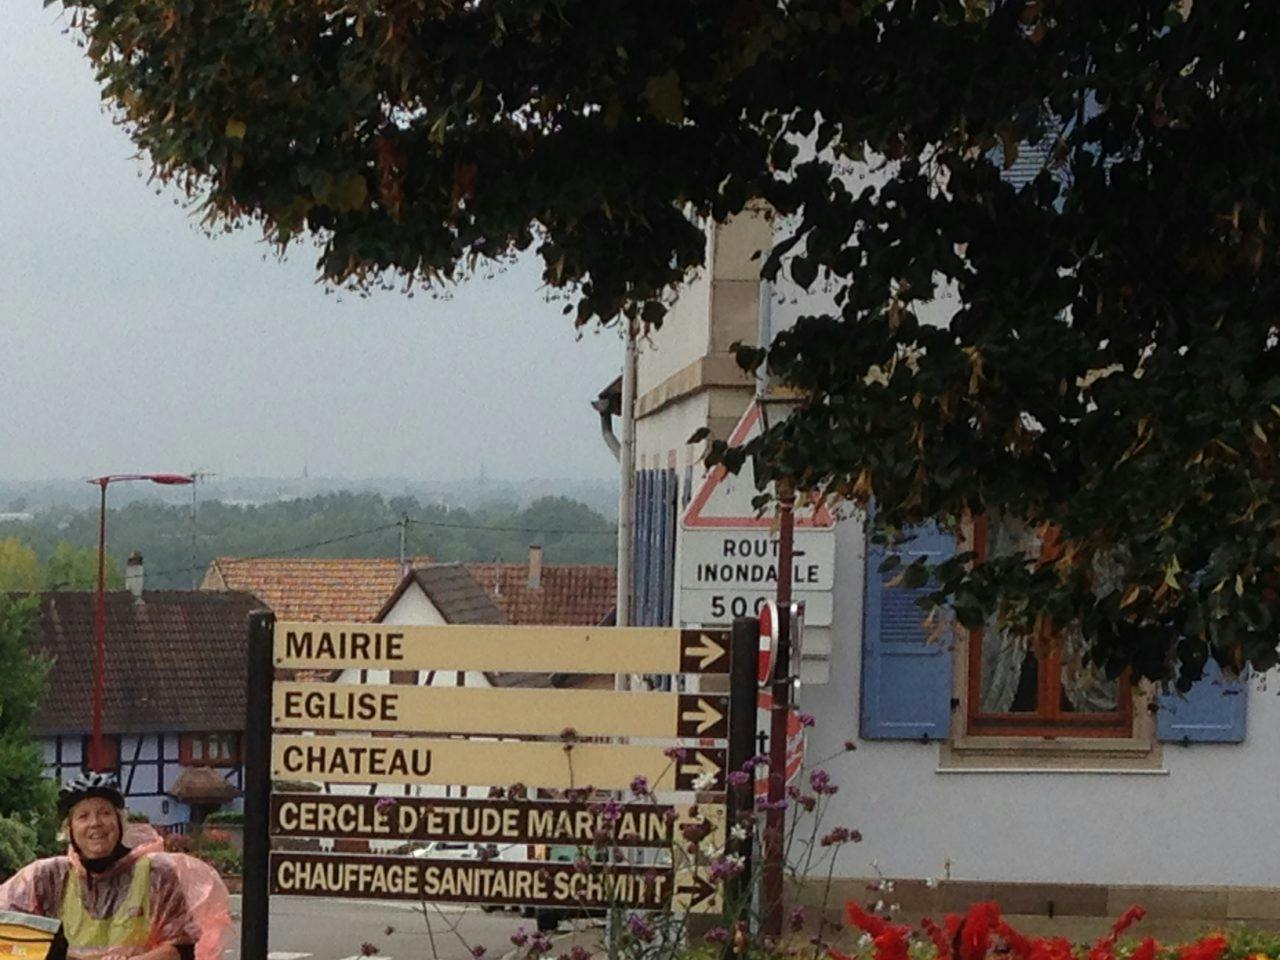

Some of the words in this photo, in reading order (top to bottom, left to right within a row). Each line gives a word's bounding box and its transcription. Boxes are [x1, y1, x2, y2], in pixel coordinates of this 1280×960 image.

[723, 539, 805, 557] ROUT
[697, 564, 819, 582] INONDALE
[285, 631, 404, 660] MAIRIE
[284, 691, 399, 722] EGLISE
[282, 745, 432, 777] CHATEAU
[278, 801, 390, 834] CERCLE
[277, 860, 419, 896] CHAUFFAGE
[424, 866, 548, 899] SANITAIRE
